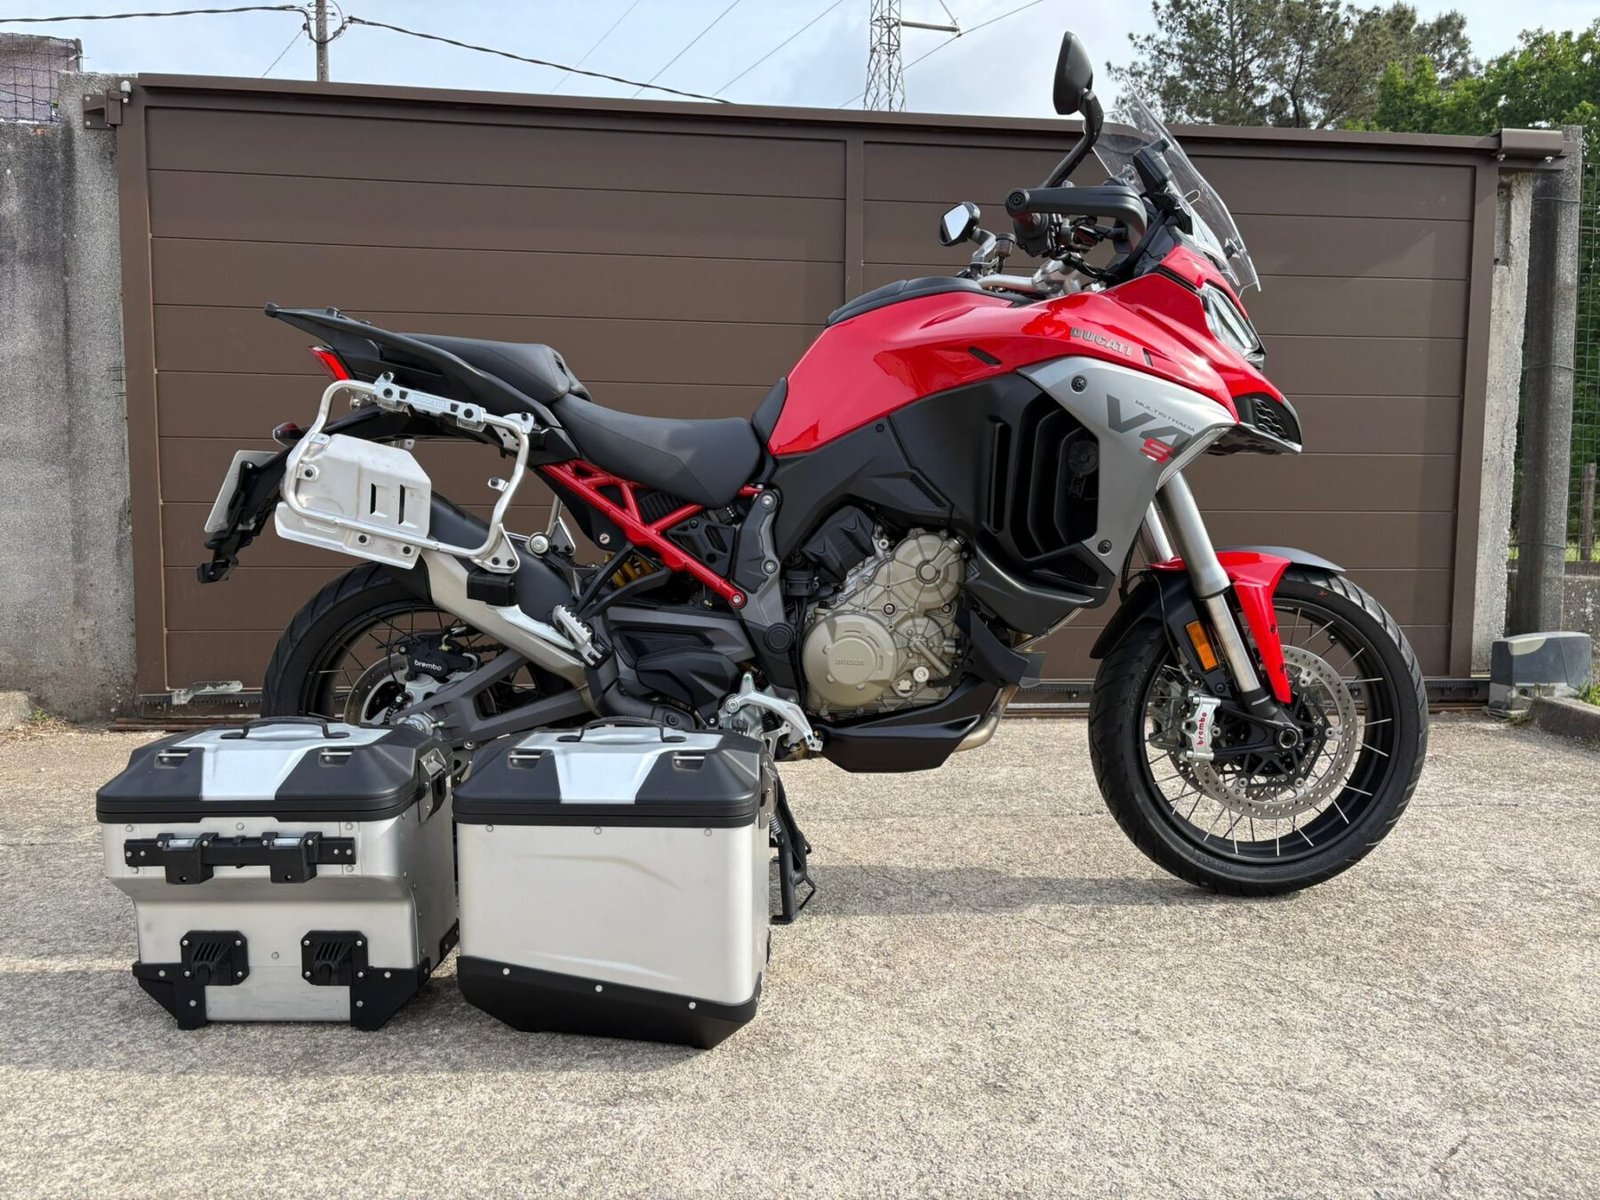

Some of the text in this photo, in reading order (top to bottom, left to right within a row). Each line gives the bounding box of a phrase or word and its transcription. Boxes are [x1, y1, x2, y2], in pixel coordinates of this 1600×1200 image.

[1070, 327, 1133, 357] DUCATI
[1134, 399, 1195, 433] MULTISTRADA
[414, 659, 442, 671] brembo
[1196, 712, 1207, 746] brembo
